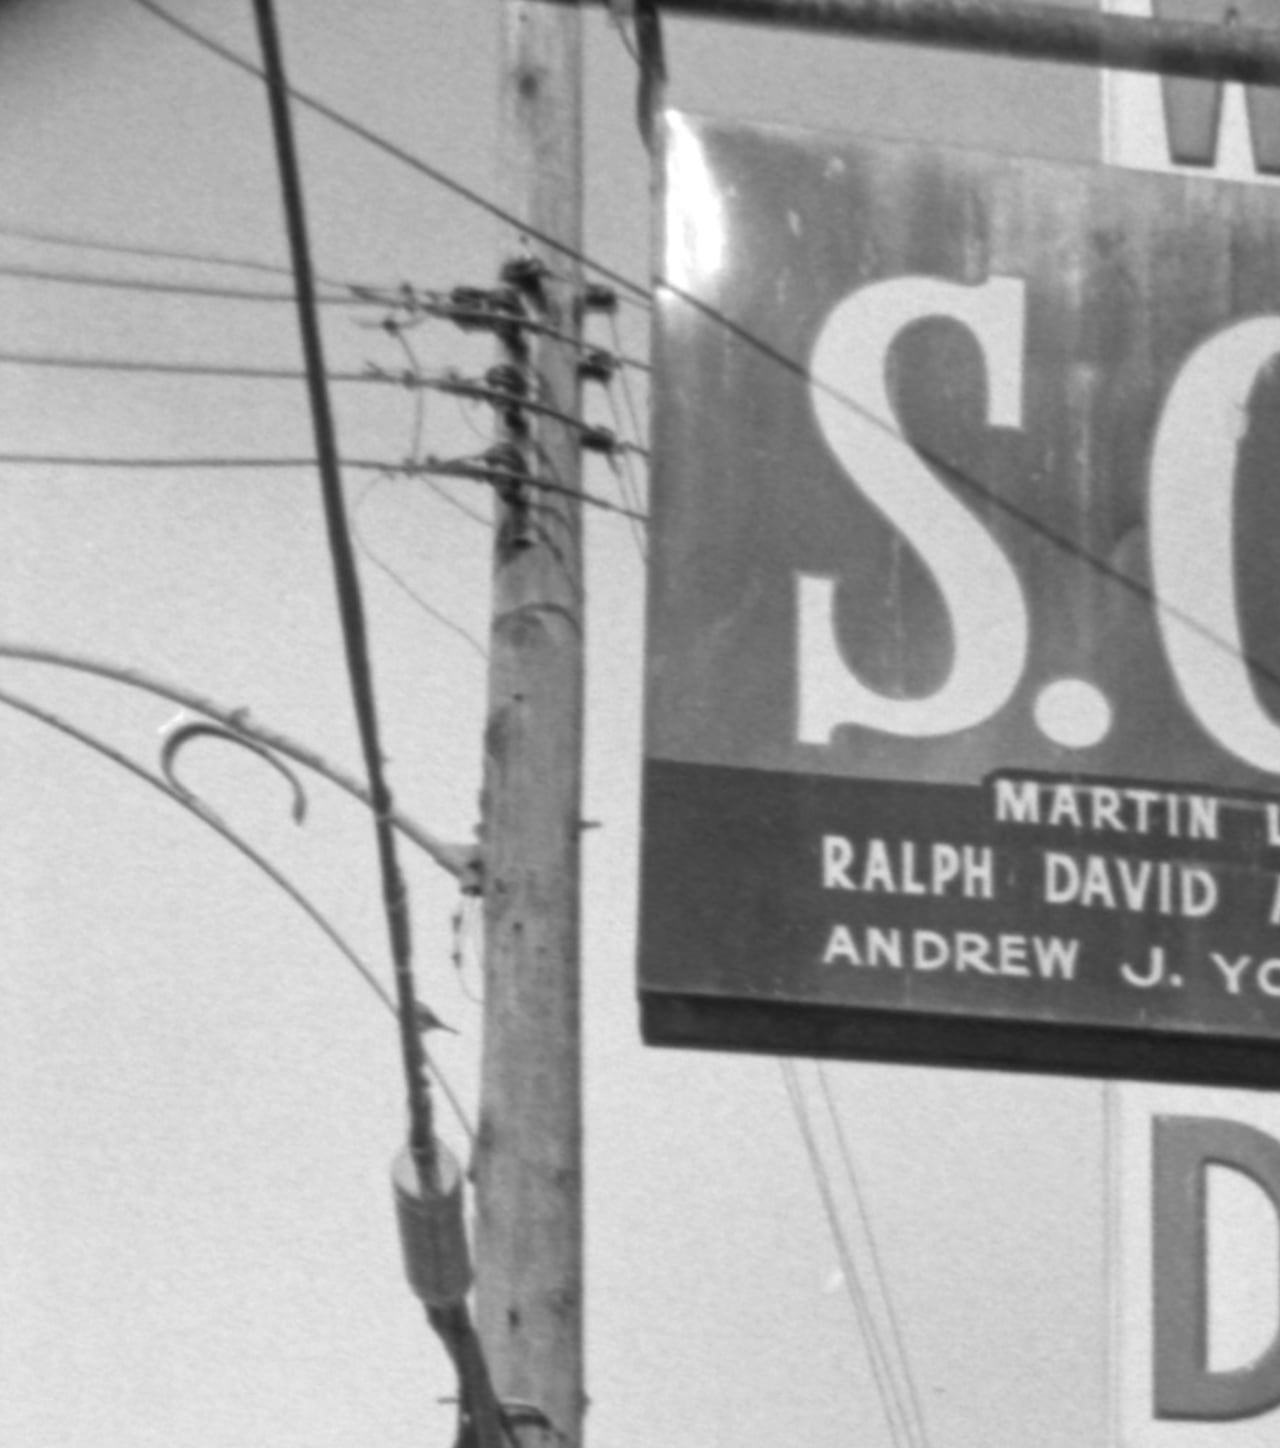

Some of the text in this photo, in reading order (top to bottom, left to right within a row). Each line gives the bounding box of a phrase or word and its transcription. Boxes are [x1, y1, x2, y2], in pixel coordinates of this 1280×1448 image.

[994, 779, 1221, 841] MARTIN
[821, 834, 995, 899] RALPH
[1044, 852, 1219, 918] DAVID
[821, 924, 1081, 981] ANDREW
[1120, 946, 1183, 989] J.
